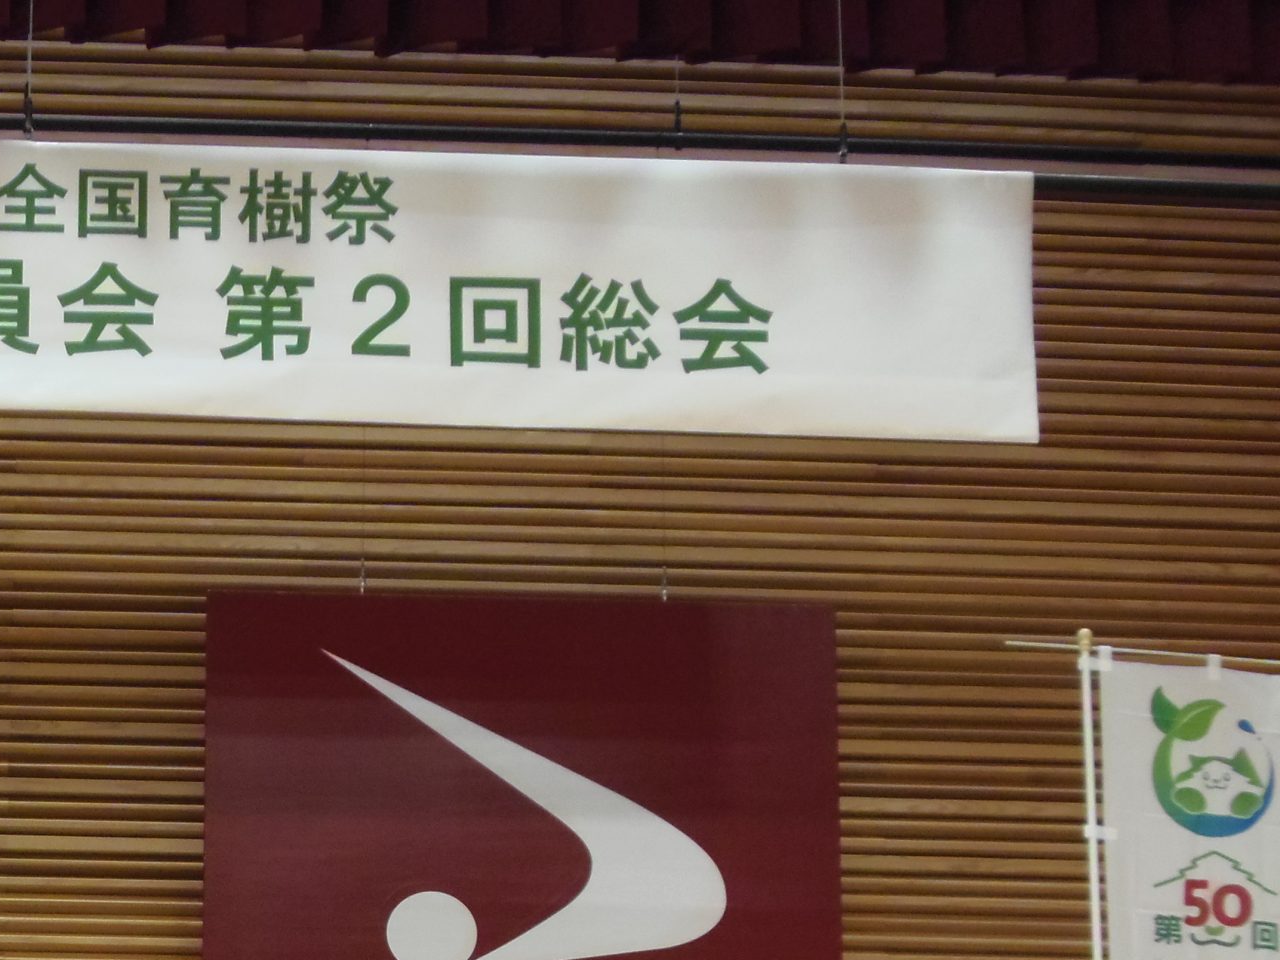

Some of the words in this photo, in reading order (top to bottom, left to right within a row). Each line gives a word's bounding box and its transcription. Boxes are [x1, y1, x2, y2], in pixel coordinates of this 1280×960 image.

[214, 264, 774, 376] 第2回総会
[1154, 879, 1280, 951] 第50回
